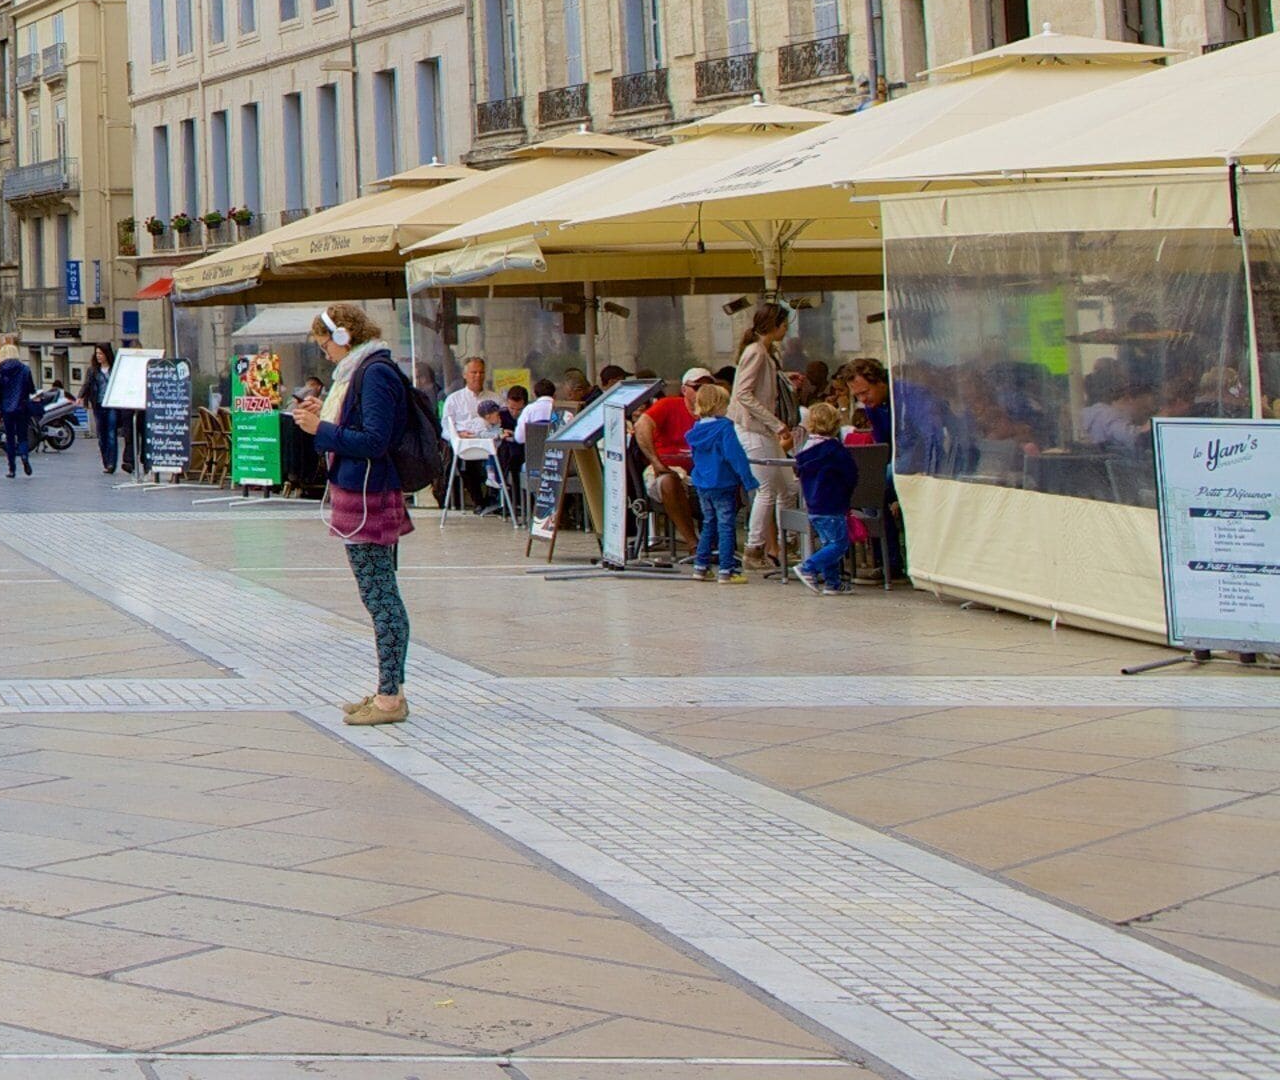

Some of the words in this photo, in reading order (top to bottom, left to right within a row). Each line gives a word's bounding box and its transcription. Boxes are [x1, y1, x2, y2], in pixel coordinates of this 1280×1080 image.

[70, 263, 78, 296] PHOTO
[234, 396, 273, 413] PIZZA
[1206, 434, 1258, 471] Yam's
[1195, 486, 1222, 497] Petit
[1224, 487, 1271, 500] Déjeuner
